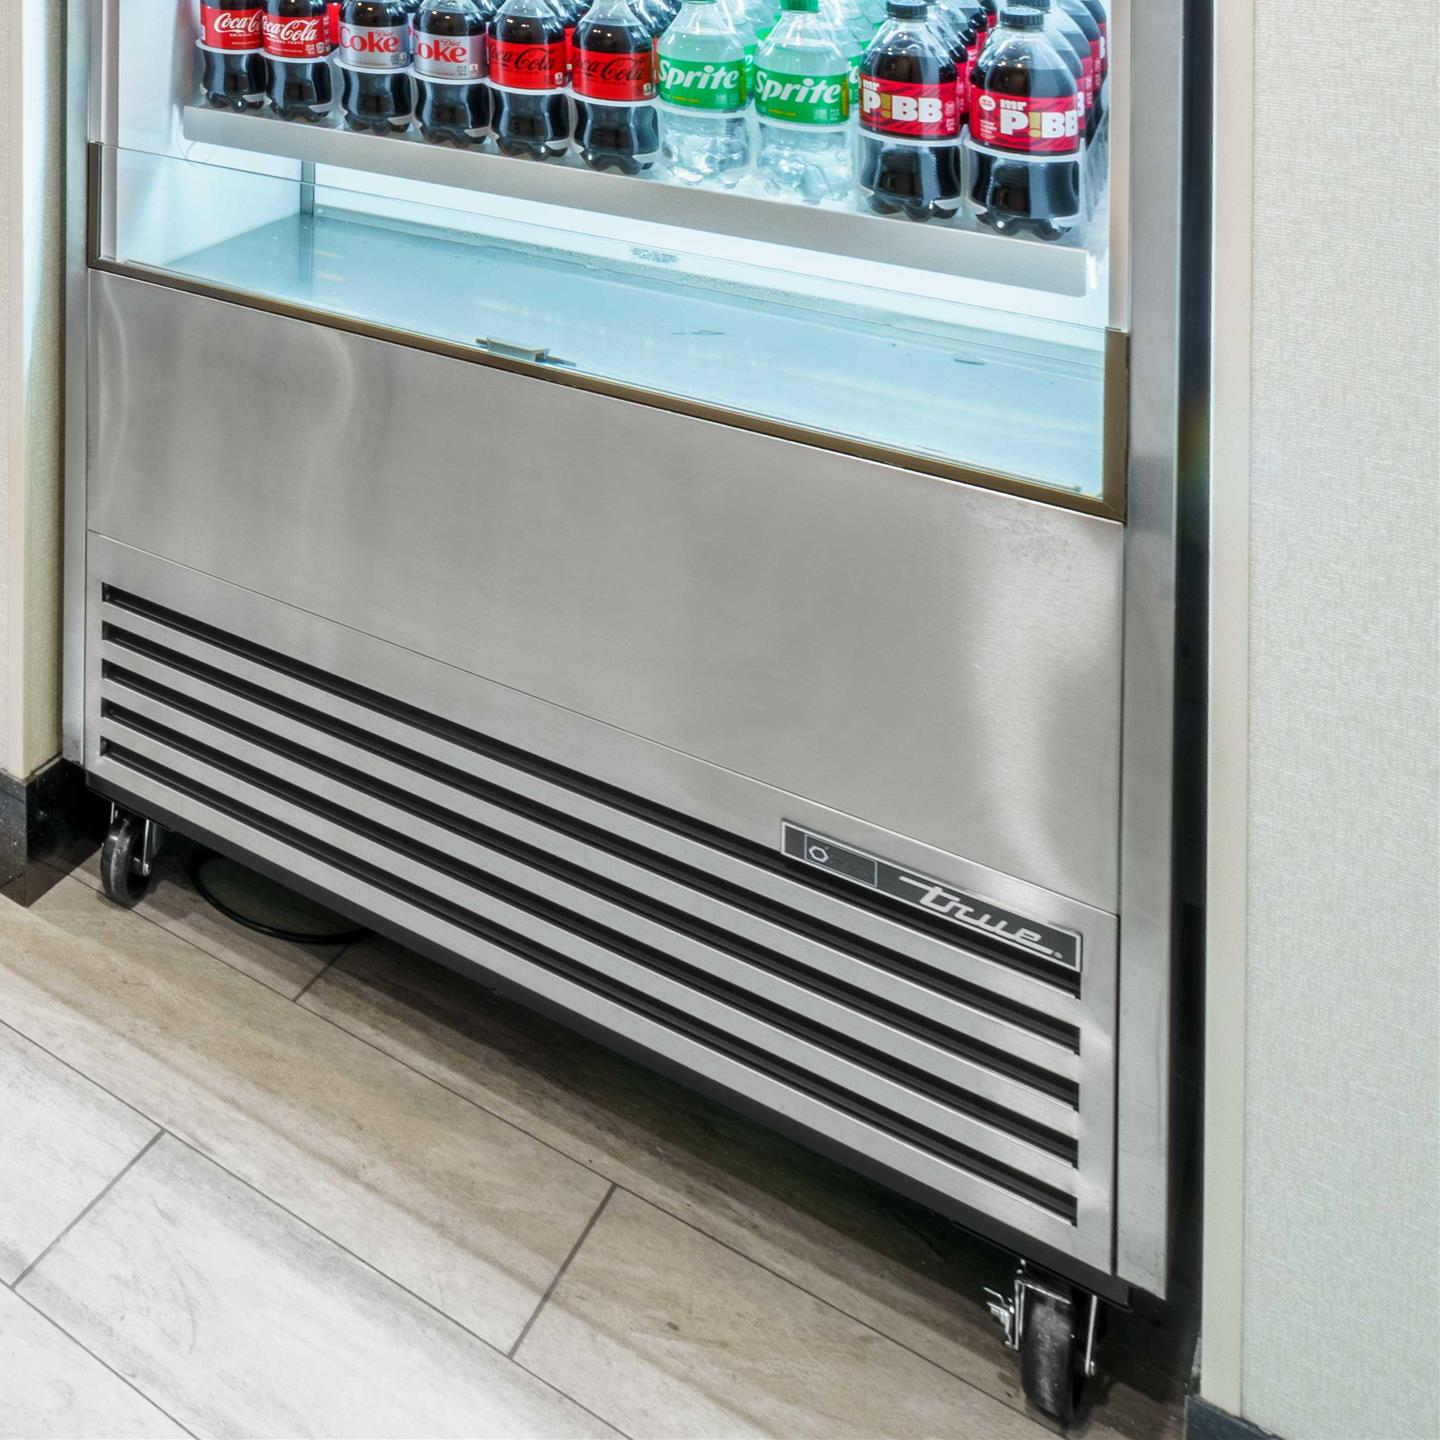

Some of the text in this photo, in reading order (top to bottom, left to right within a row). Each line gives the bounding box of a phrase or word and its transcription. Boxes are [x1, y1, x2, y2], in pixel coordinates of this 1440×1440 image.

[339, 25, 400, 54] Coke
[658, 60, 740, 90] Sprite
[754, 70, 842, 104] Sprite
[862, 79, 880, 91] mr
[1000, 98, 1027, 111] mr
[901, 877, 1050, 952] true
